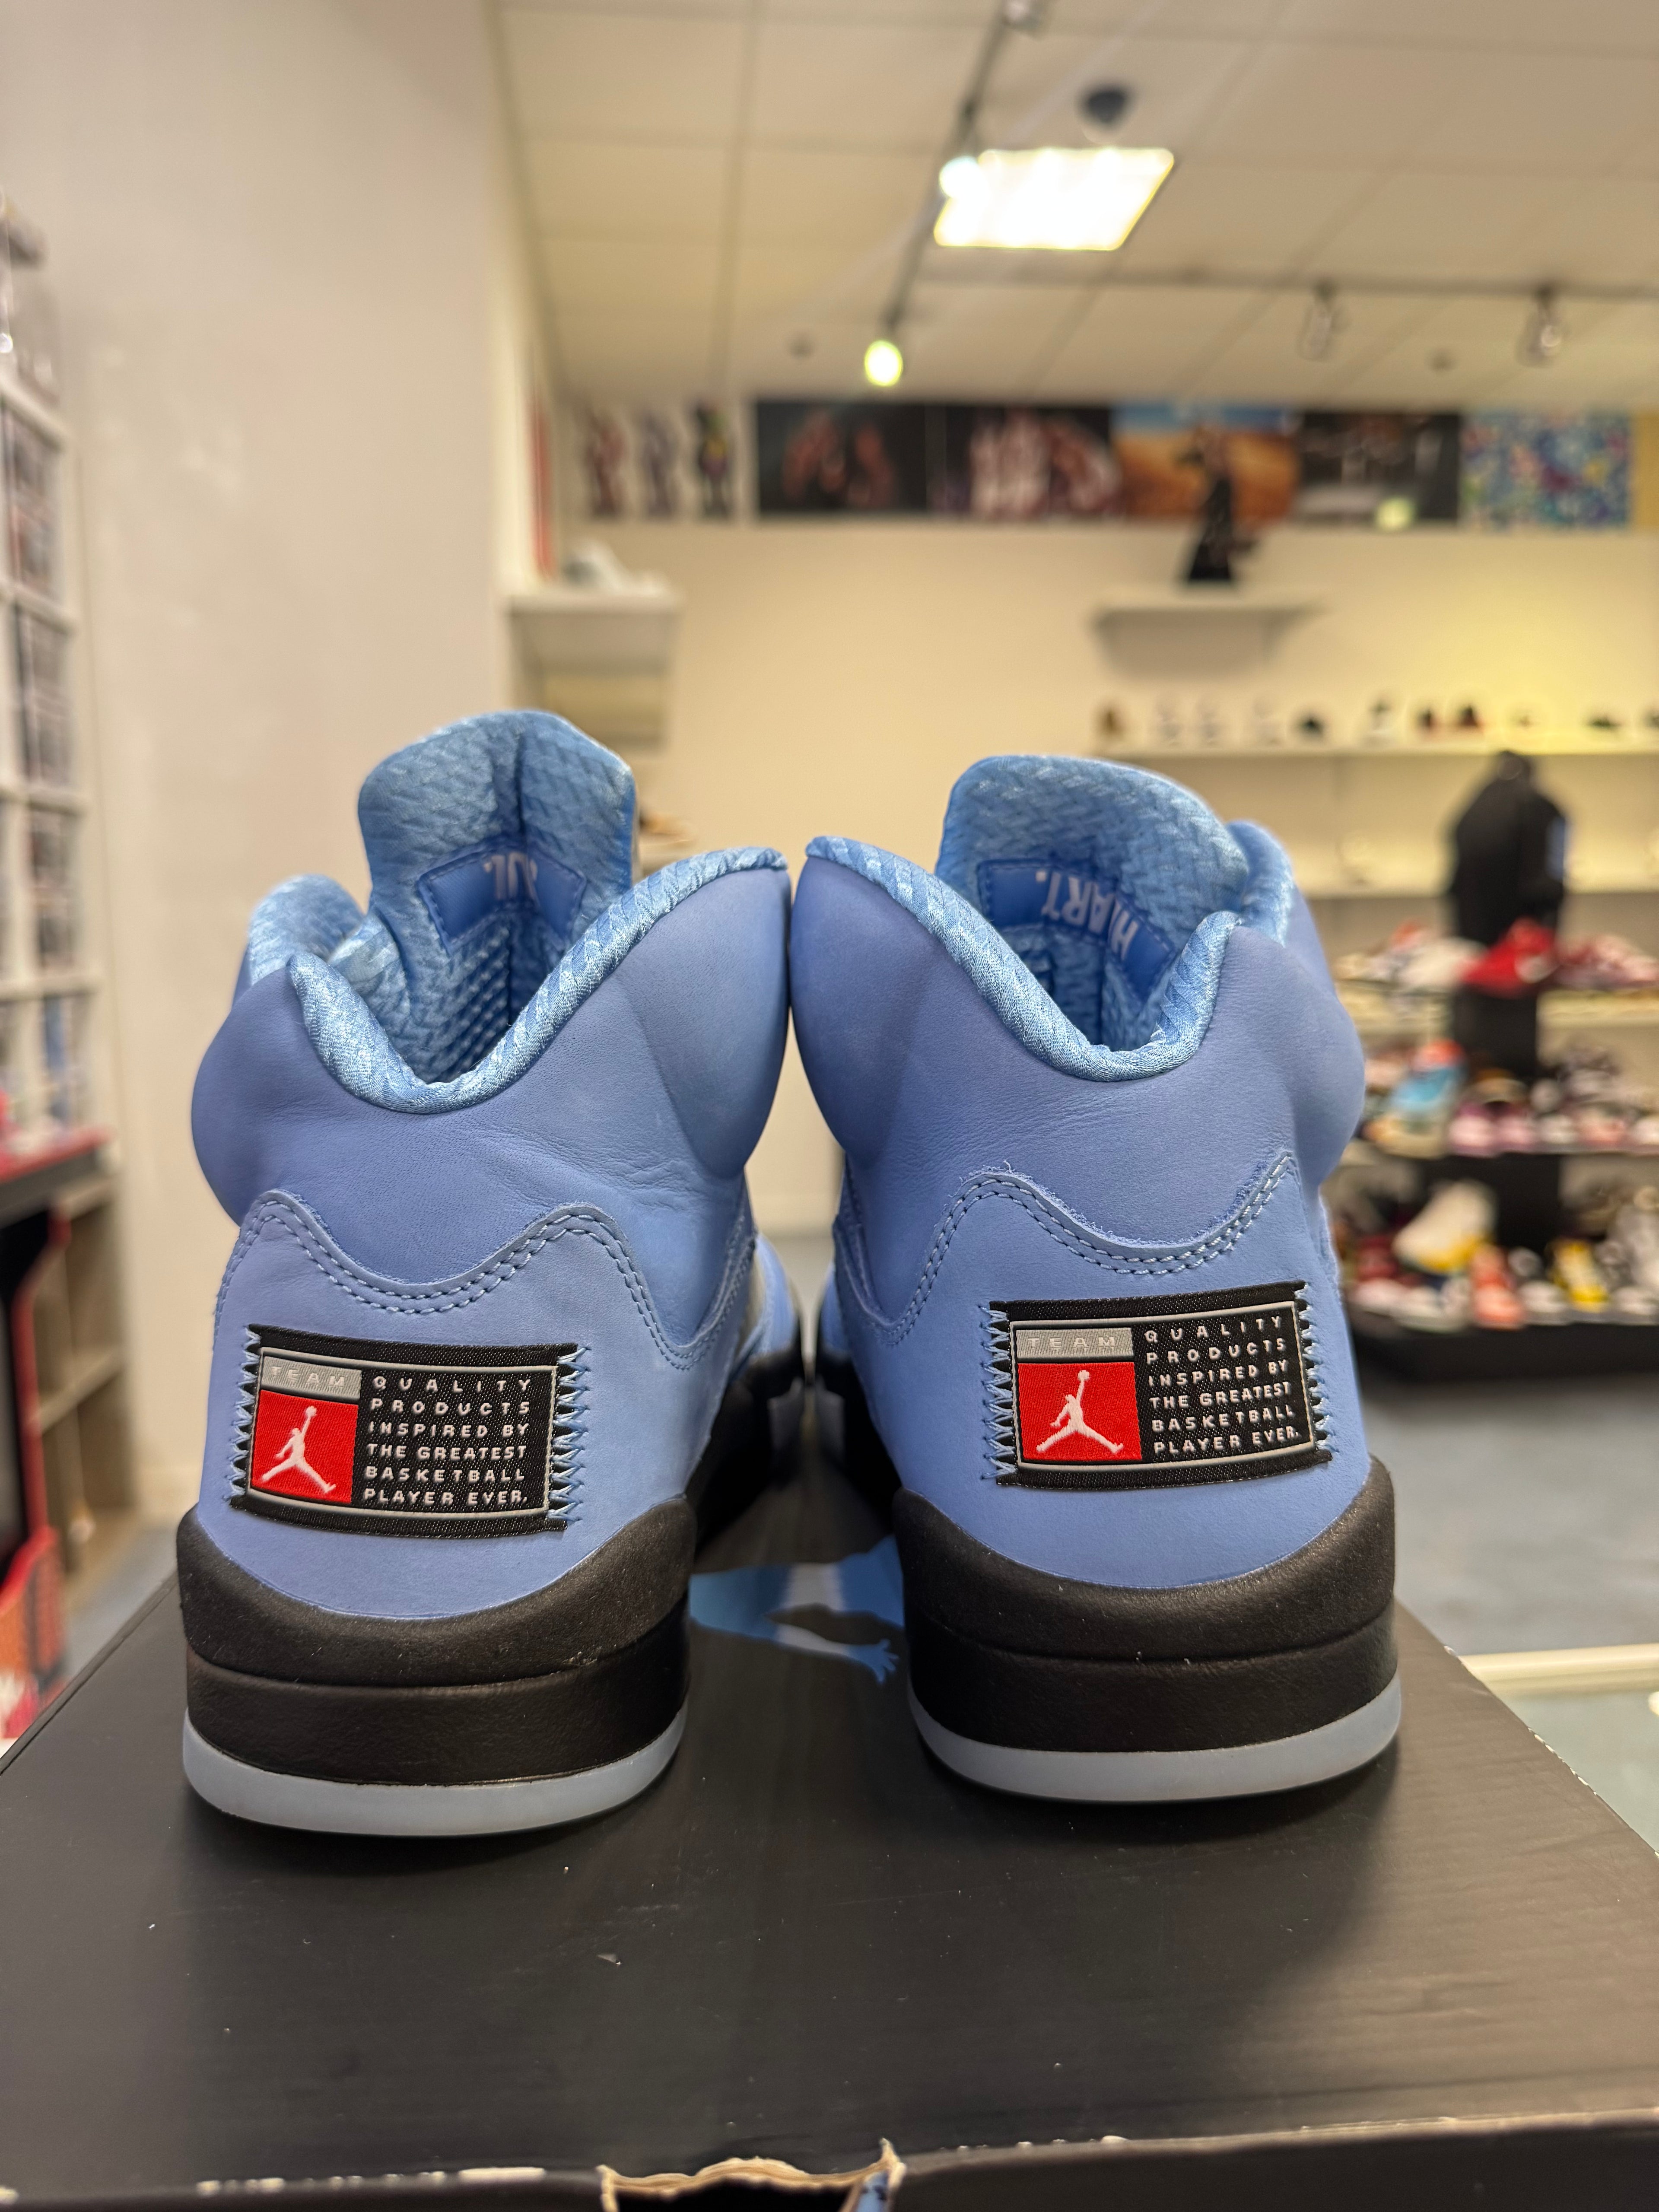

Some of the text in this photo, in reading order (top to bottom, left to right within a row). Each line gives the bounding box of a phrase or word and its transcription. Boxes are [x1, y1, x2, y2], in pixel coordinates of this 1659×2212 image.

[1144, 1316, 1281, 1343] QUALITY
[1027, 1336, 1116, 1349] TEAM
[1146, 1338, 1285, 1365] PRODUCTS
[271, 1366, 345, 1388] TEAM
[1148, 1360, 1288, 1387] INSPIRED BY
[373, 1376, 531, 1393] QUALITY
[1150, 1382, 1292, 1409] THE GREATEST
[372, 1398, 530, 1415] PRODUCTS
[1152, 1404, 1296, 1433] BASKETBALL
[369, 1421, 529, 1437] INSPIRED BY
[368, 1443, 527, 1460] THE GREATEST
[1154, 1434, 1240, 1454] PLAYER
[366, 1465, 525, 1482] BASKETBALL
[364, 1488, 454, 1505] PLAYER
